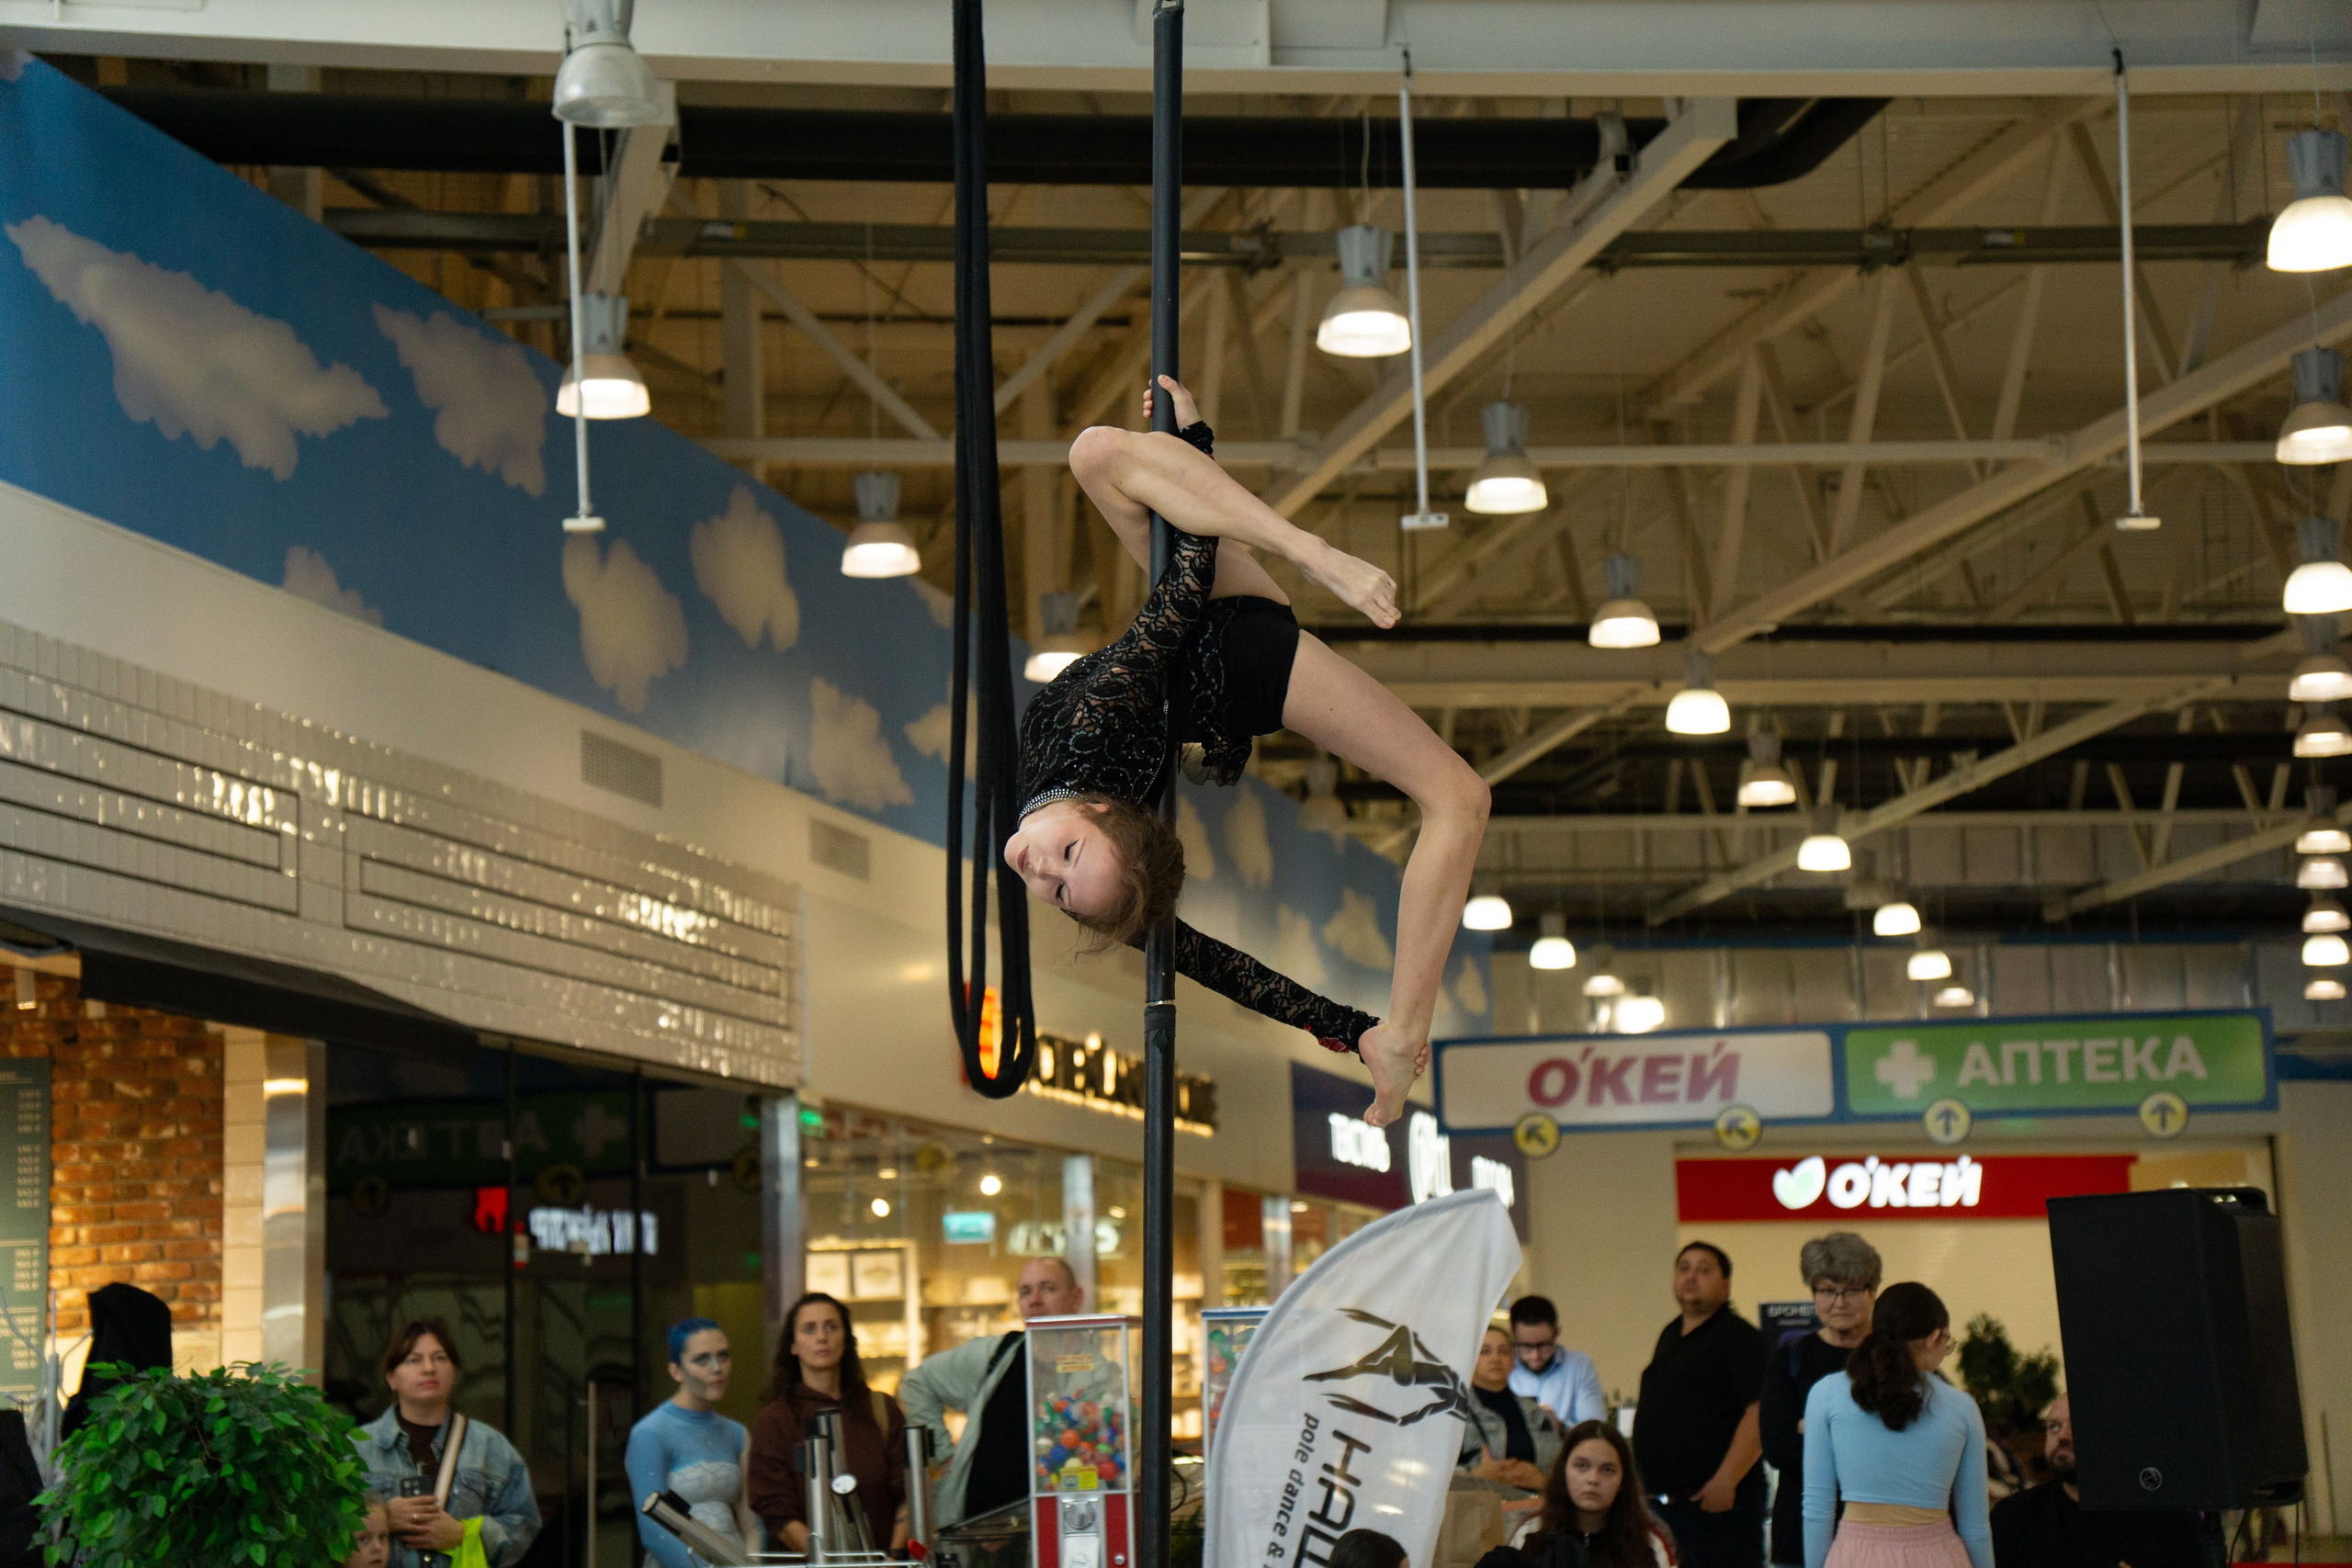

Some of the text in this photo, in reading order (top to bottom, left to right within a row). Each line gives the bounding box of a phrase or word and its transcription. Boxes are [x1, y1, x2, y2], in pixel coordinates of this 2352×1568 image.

[1957, 1035, 2208, 1088] АПТЕКА
[1295, 1412, 1320, 1463] pole
[1273, 1468, 1306, 1538] dance
